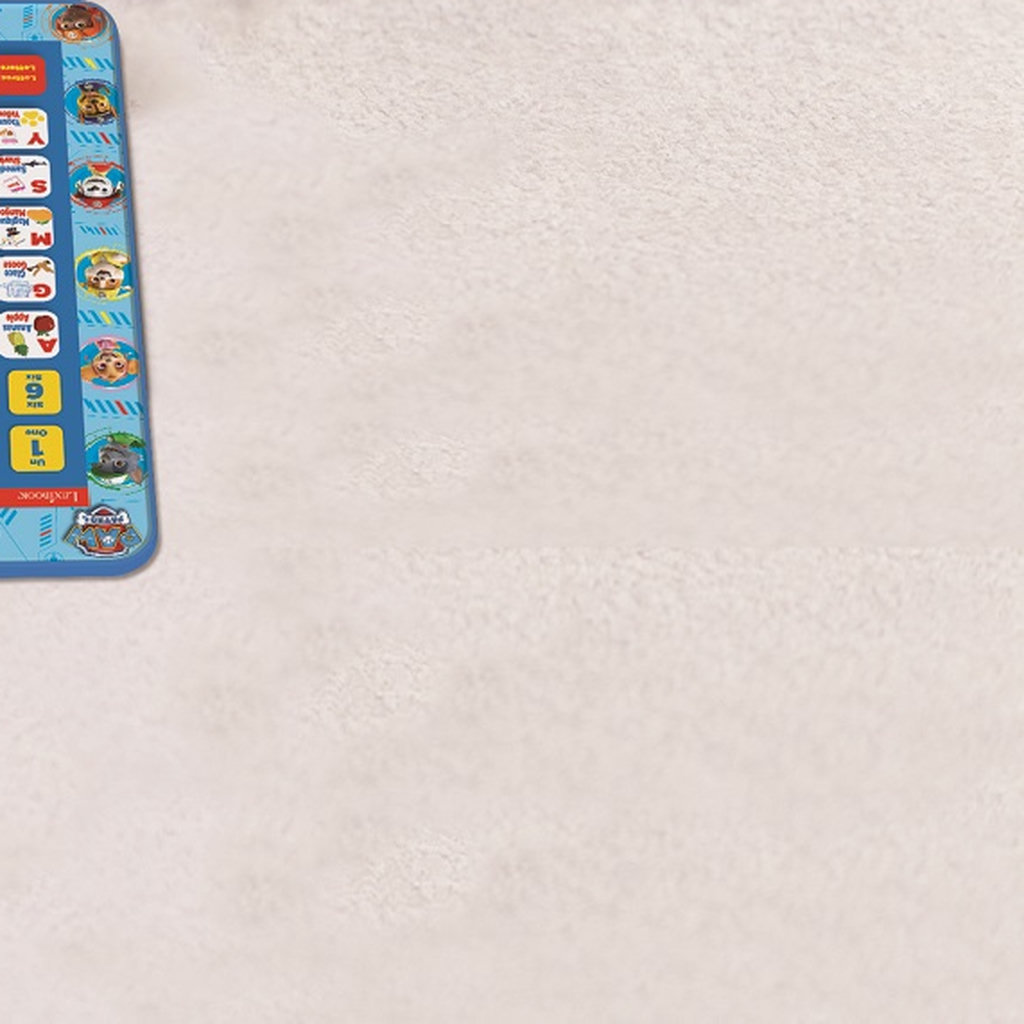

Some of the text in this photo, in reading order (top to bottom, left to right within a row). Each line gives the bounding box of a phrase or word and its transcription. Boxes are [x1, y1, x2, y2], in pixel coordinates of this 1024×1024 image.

[26, 131, 46, 145] Y
[30, 179, 48, 194] S
[30, 232, 52, 247] M
[32, 283, 52, 298] G
[5, 313, 29, 323] Apple
[36, 338, 58, 354] A
[27, 373, 42, 382] Six
[25, 382, 44, 401] 6
[26, 401, 44, 409] Six
[24, 428, 48, 437] One
[31, 439, 44, 457] 1
[29, 458, 46, 467] Un
[62, 524, 143, 552] PAW
